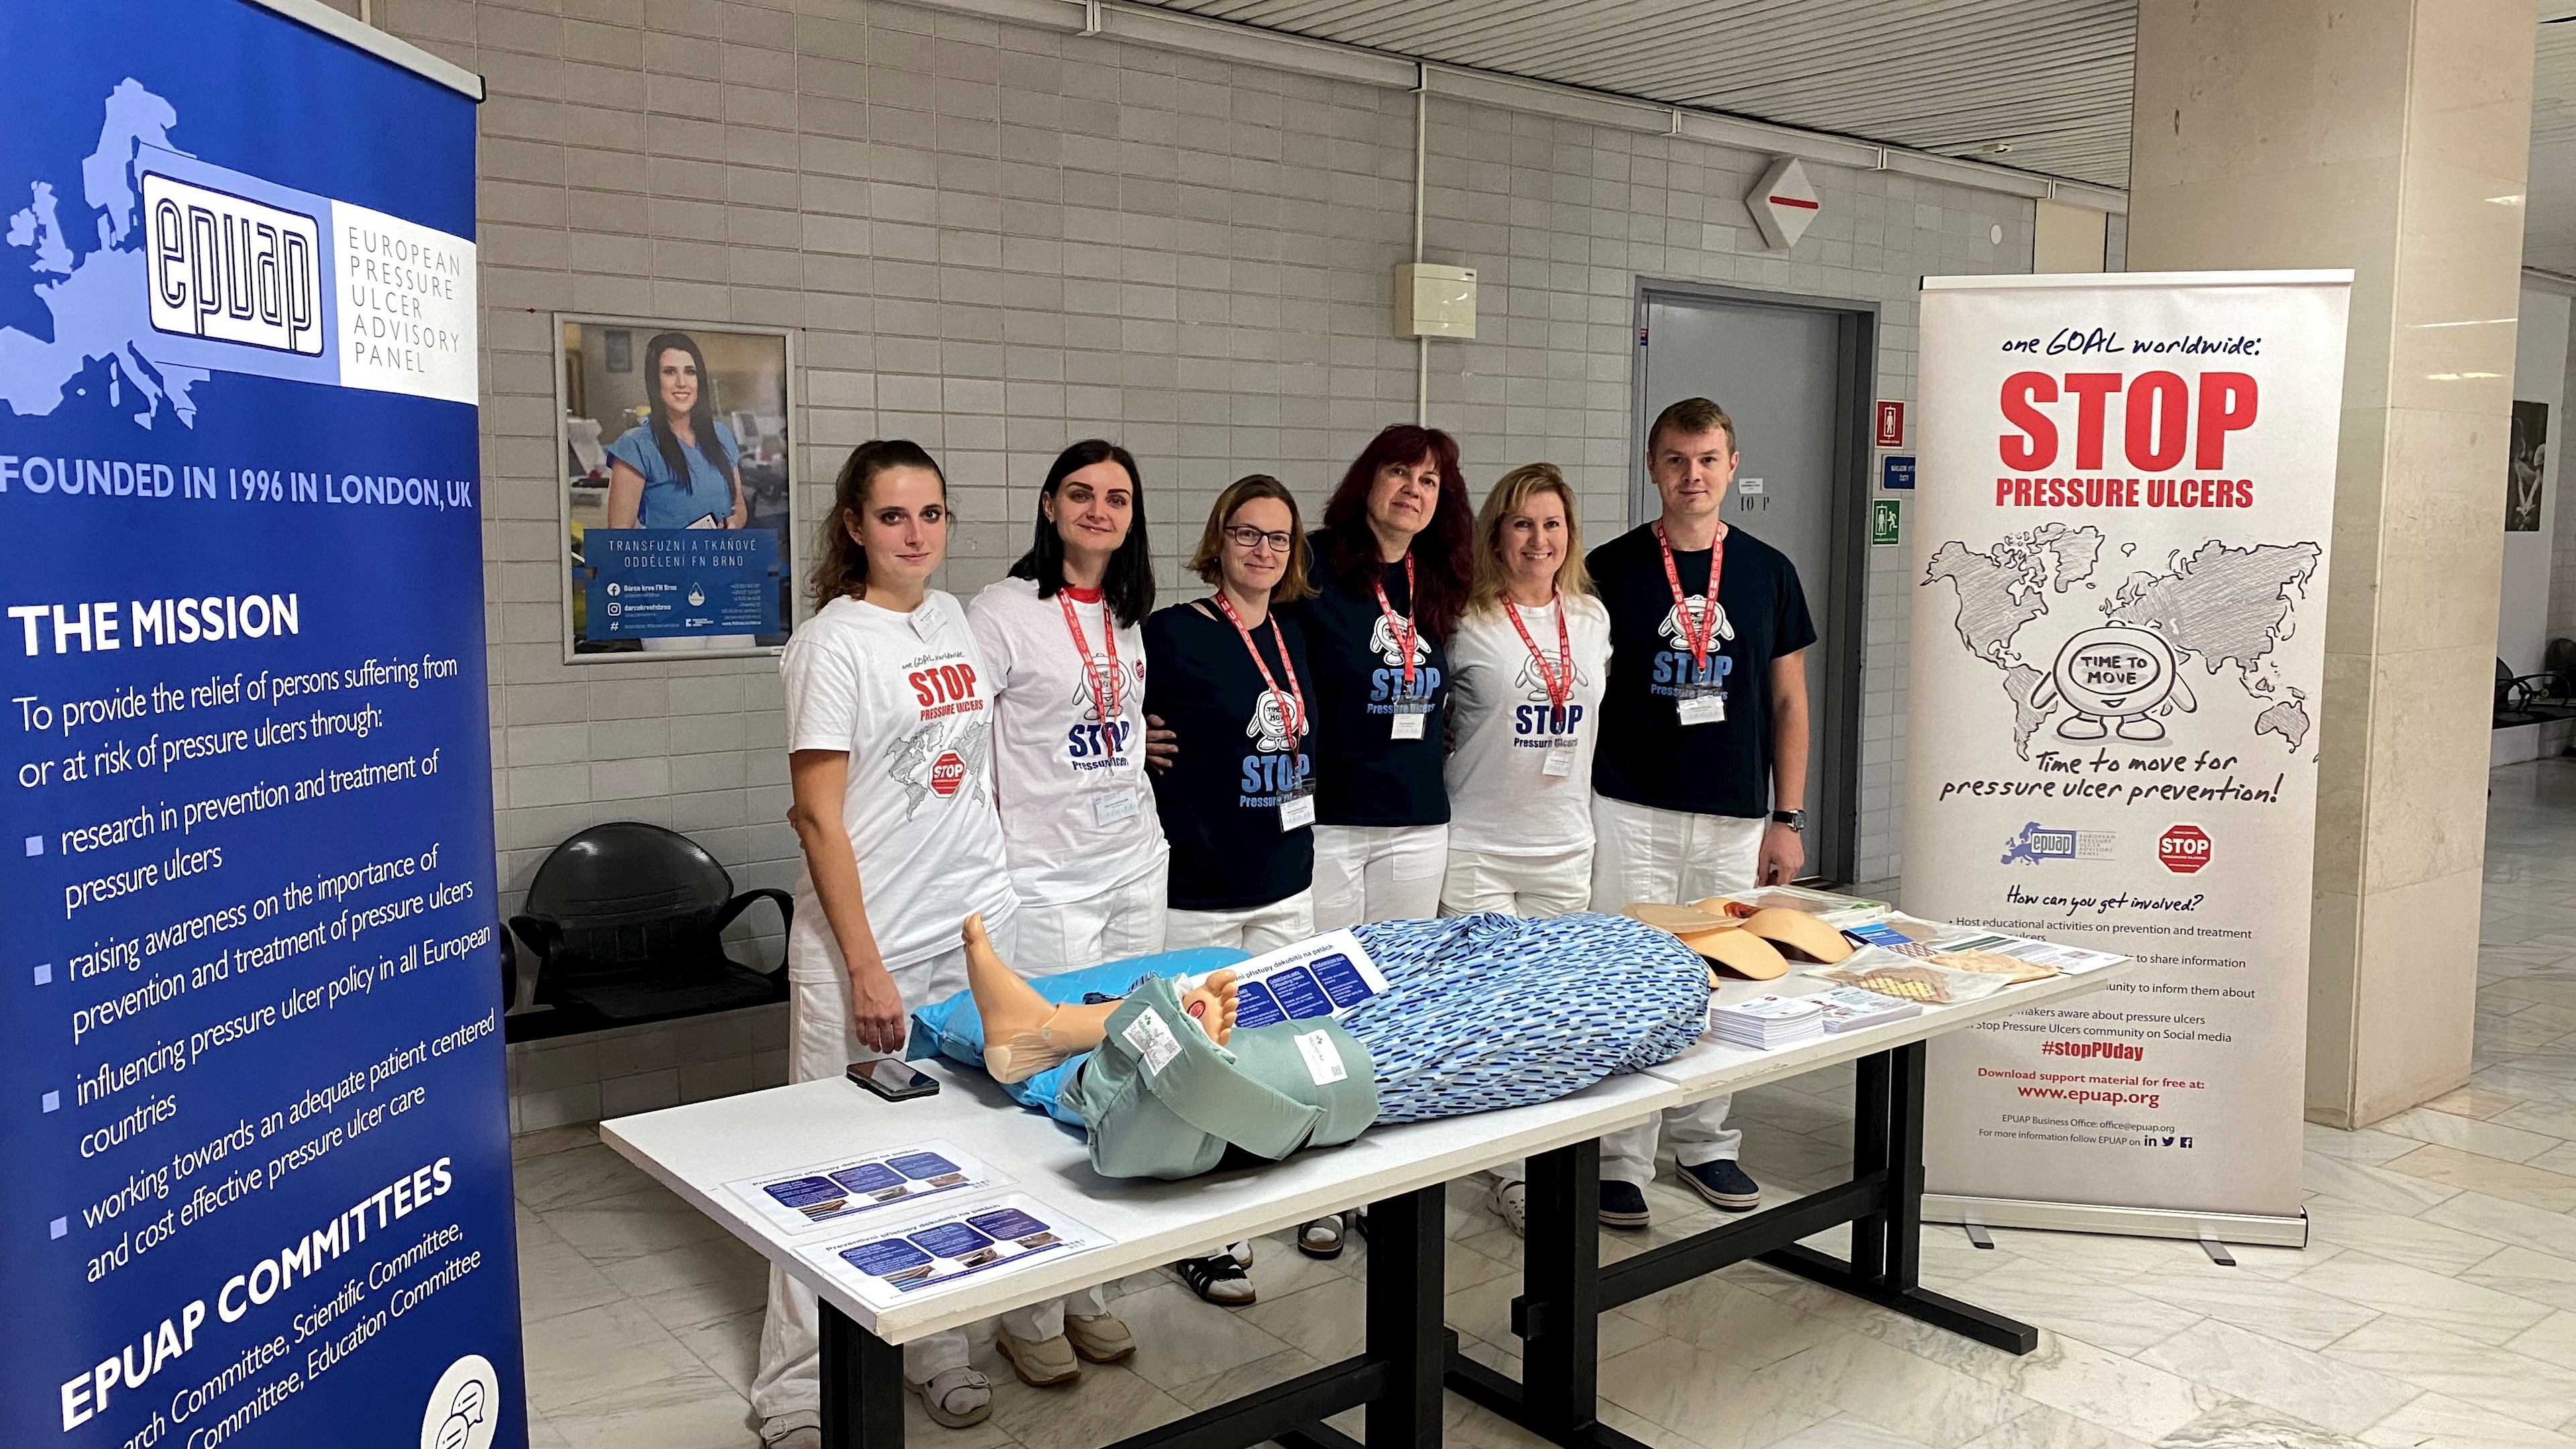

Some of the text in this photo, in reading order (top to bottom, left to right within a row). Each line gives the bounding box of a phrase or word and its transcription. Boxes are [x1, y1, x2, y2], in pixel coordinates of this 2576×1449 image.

[349, 227, 461, 276] EUROPEAN
[156, 198, 313, 350] epuap
[350, 256, 454, 301] PRESSURE
[352, 285, 423, 320] ULCER
[354, 315, 460, 354] ADVISORY
[2002, 327, 2262, 356] one GOAL worldwide:
[356, 342, 426, 374] PANEL
[2000, 371, 2257, 472] STOP
[0, 455, 472, 512] FOUNDED IN 1996 IN LONDON, UK
[1996, 478, 2253, 508] PRESSURE ULCERS
[609, 539, 684, 551] TRANSFUZNÍ
[692, 541, 697, 551] A
[624, 554, 743, 568] ODDĚLENÍ FN BRNO
[8, 593, 299, 656] THE MISSION
[1653, 651, 1732, 687] STOP
[2081, 656, 2147, 669] TIME TO
[909, 664, 976, 706] STOP
[1371, 667, 1440, 701] STOP
[2088, 672, 2137, 684] MOVE
[12, 654, 457, 737] To provide the relief of persons suffering from
[920, 704, 955, 720] PRESSURE
[1516, 705, 1582, 735] STOP
[19, 704, 382, 788] or at risk of pressure ulcers through:
[2037, 747, 2237, 774] Time to move for
[933, 764, 963, 779] STOP
[1242, 754, 1309, 792] STOP
[62, 749, 439, 855] research in prevention and treatment of
[1940, 773, 2284, 805] pressure ulcer prevention!
[2033, 835, 2070, 854] epuap
[2161, 838, 2209, 855] STOP
[65, 845, 223, 919] pressure ulcers
[69, 843, 439, 982] raising awareness on the importance of
[2006, 884, 2204, 916] How can you get involved?
[1956, 917, 2253, 938] Host educational activities on prevention and treatment
[2137, 953, 2246, 969] to share information
[2139, 983, 2255, 999] to inform them about
[2003, 1021, 2047, 1032] Pressure
[2049, 1023, 2081, 1034] Ulcers
[2084, 1026, 2144, 1039] community
[2163, 1028, 2195, 1040] Social
[2198, 1031, 2232, 1042] media
[2058, 1010, 2090, 1019] aware
[2092, 1010, 2124, 1020] about
[2126, 1012, 2171, 1024] pressure
[2174, 1014, 2205, 1024] ulcers
[2042, 1040, 2144, 1061] #stopPUday
[1978, 1068, 2205, 1089] Download support material for free at:
[2018, 1086, 2160, 1108] www.epuap.org
[1979, 1128, 1992, 1136] For
[2019, 1131, 2069, 1142] information
[2070, 1134, 2096, 1143] follow
[2098, 1136, 2127, 1145] EPUAP
[2002, 1114, 2175, 1134] EPUAP Business Office: office@epuap.org
[60, 1157, 453, 1432] EPUAP COMMITTEES
